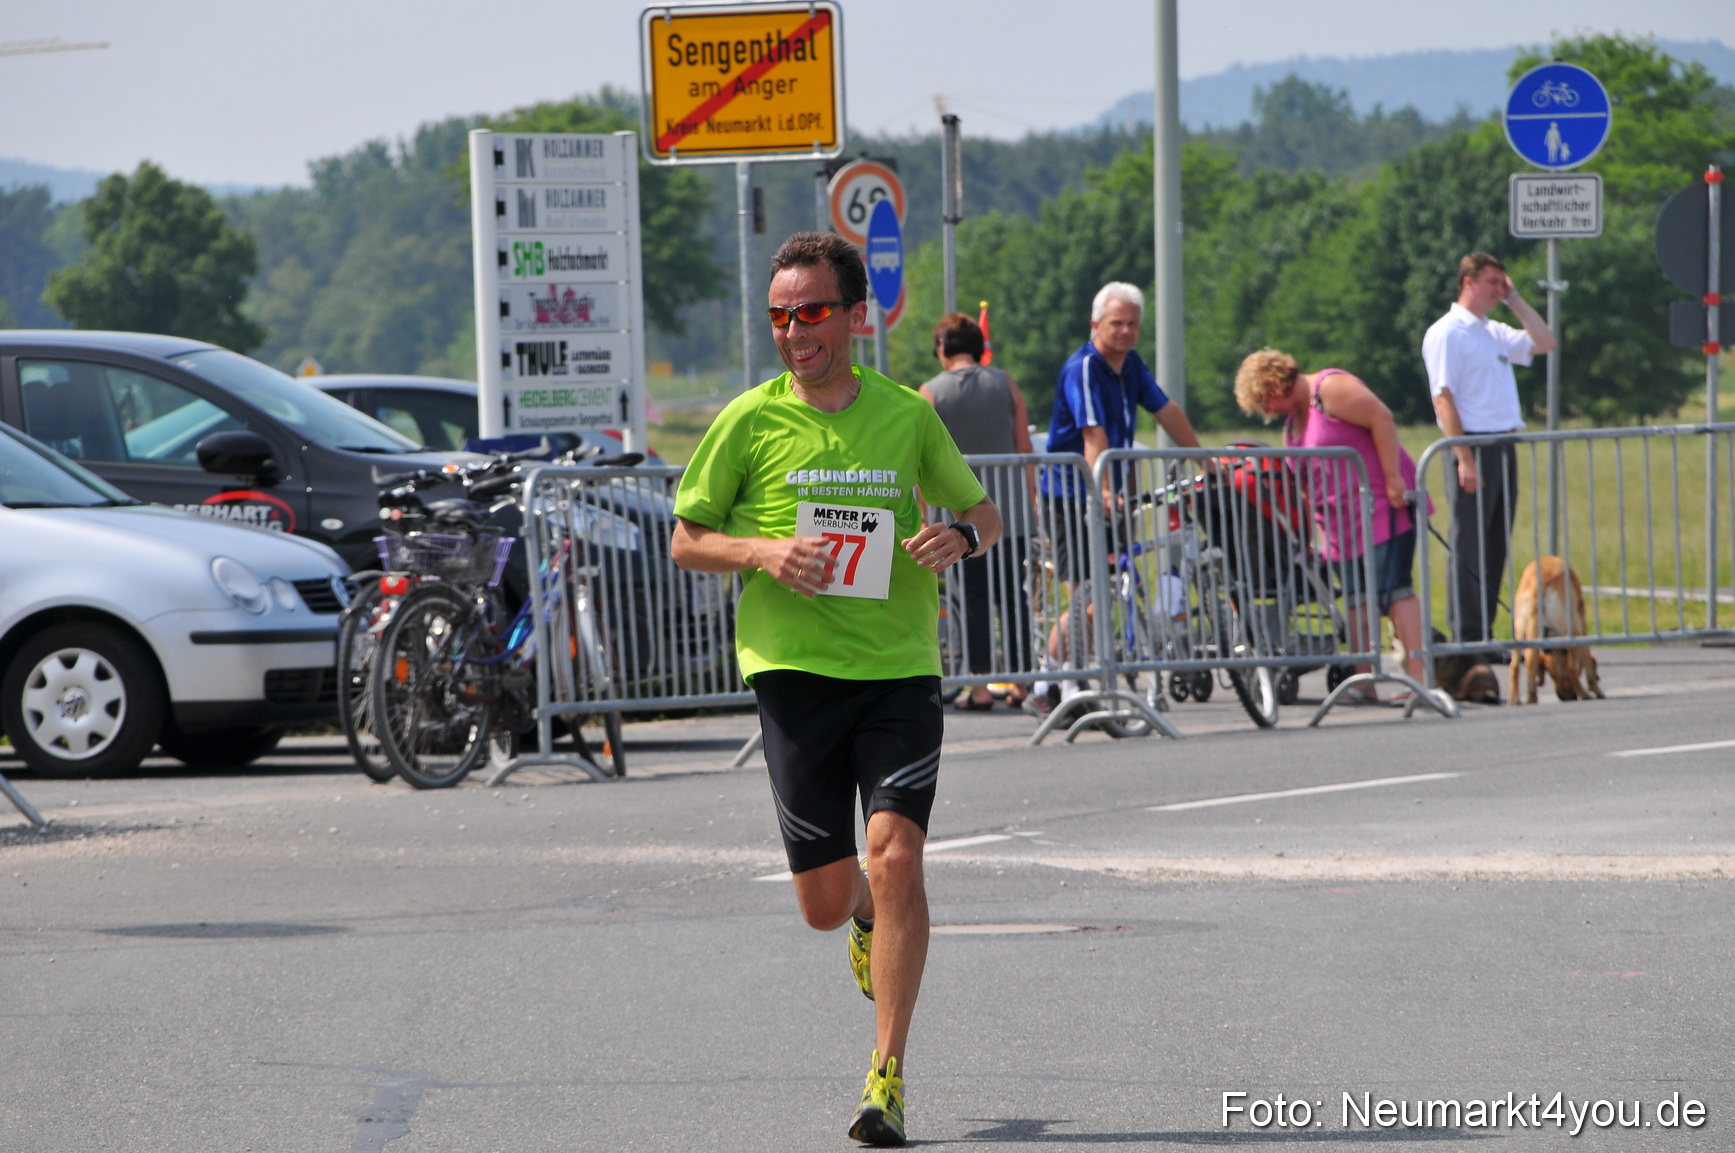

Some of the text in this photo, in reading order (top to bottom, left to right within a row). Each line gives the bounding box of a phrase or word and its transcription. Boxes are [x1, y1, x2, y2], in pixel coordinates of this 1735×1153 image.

[667, 27, 817, 74] Sengenthal
[689, 75, 798, 100] am Anger
[666, 118, 699, 135] Kreis
[706, 115, 771, 134] Neumarkt
[1527, 183, 1586, 197] Landwirt-
[1521, 200, 1590, 213] schaftlicher
[1521, 215, 1591, 229] Verkehr frei
[513, 241, 546, 278] SHB
[516, 341, 568, 376] THULE
[785, 469, 897, 485] GESUNDHEIT
[798, 484, 902, 498] IN BESTEN HÄNDEN
[813, 507, 858, 522] MEYER
[813, 519, 858, 530] WERBUNG
[821, 532, 867, 586] 77
